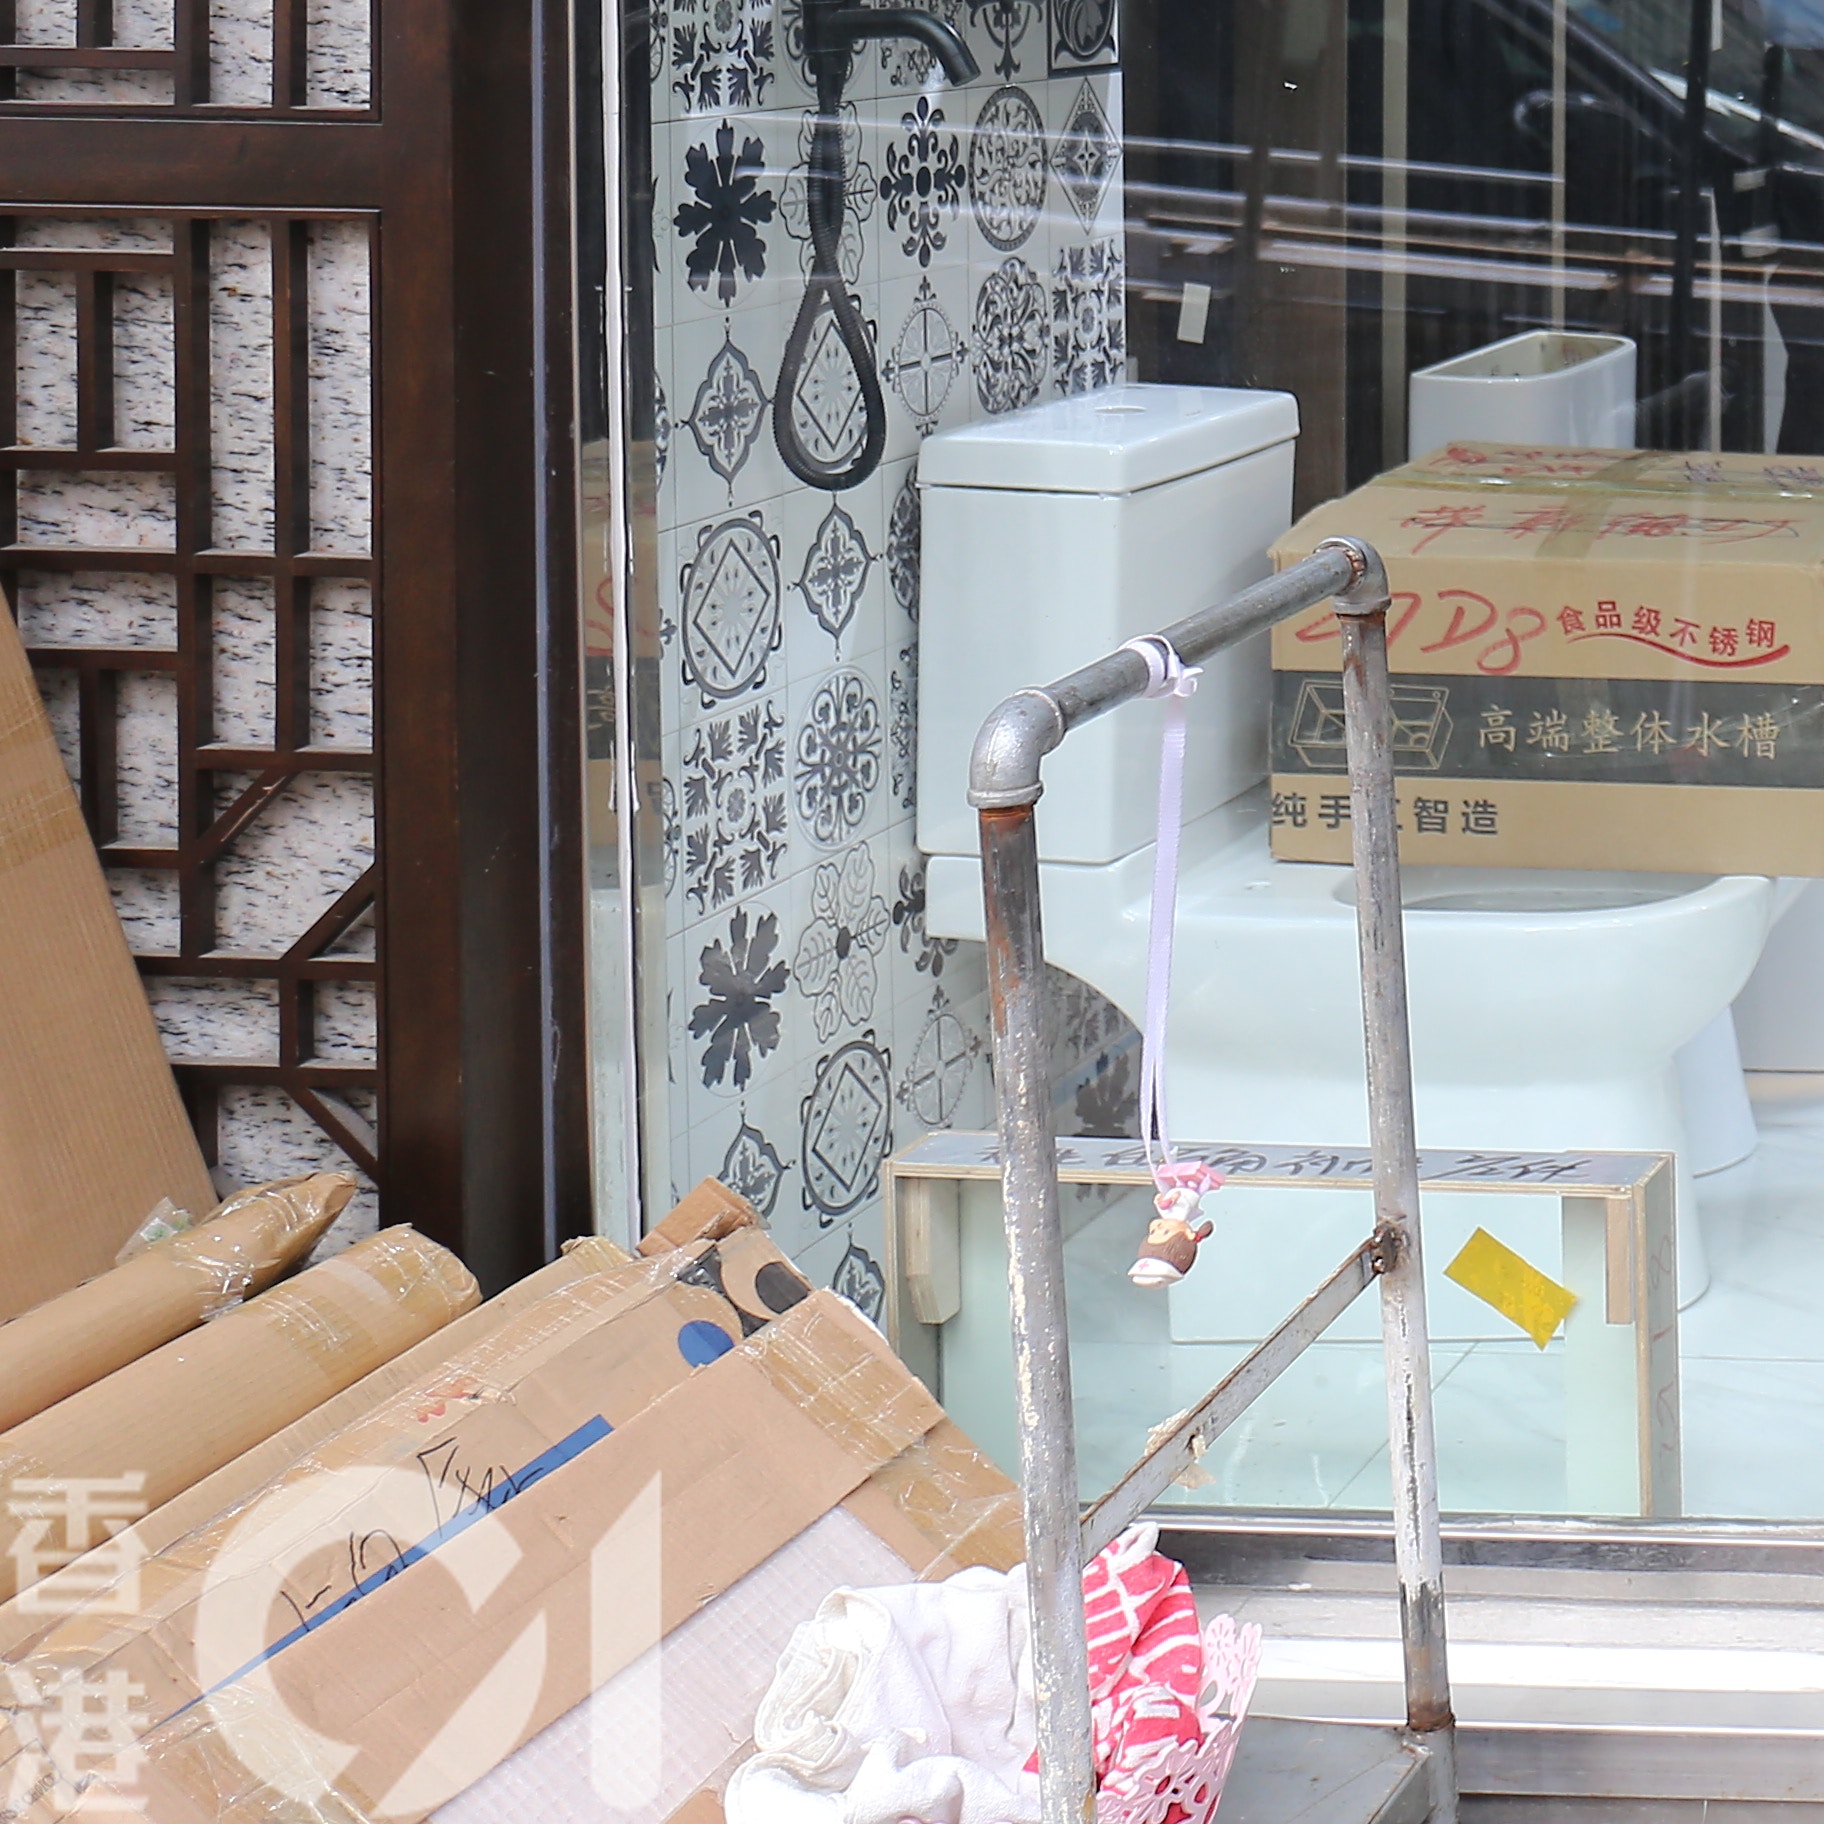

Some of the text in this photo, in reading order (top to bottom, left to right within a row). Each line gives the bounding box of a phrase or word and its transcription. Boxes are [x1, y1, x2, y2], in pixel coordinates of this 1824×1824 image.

[1555, 599, 1778, 658] 食品级不锈钢
[1478, 704, 1783, 761] 高端整体水槽
[1271, 793, 1500, 836] 纯手智造
